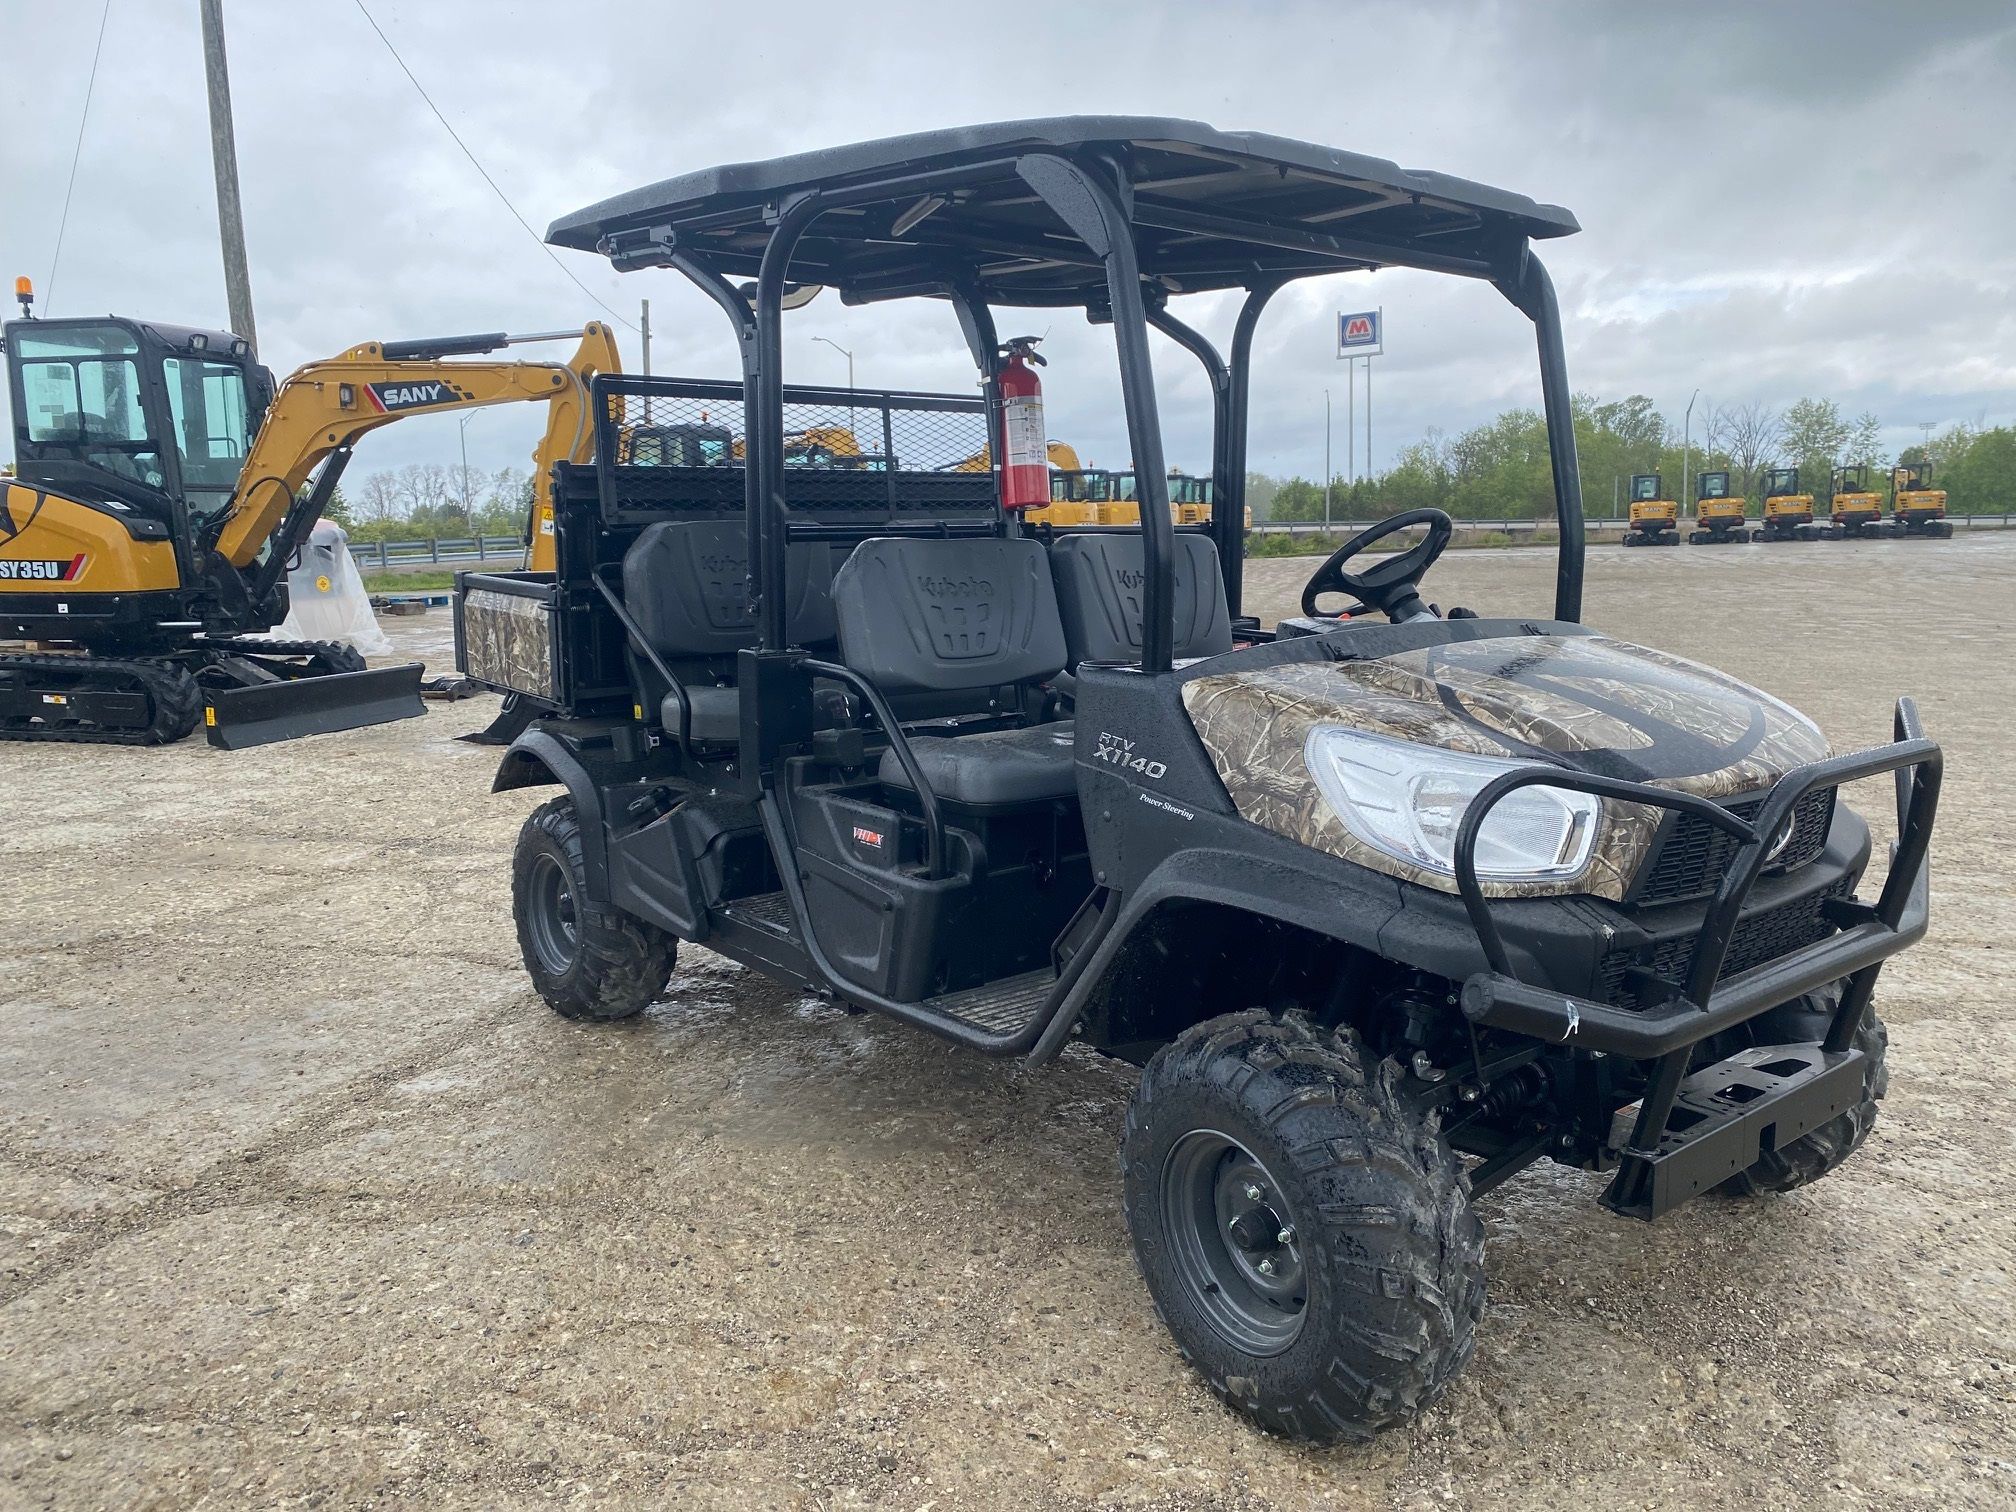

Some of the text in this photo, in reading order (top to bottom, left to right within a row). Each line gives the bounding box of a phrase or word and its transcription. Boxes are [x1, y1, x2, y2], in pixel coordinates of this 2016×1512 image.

[384, 384, 441, 405] SANY
[0, 561, 58, 579] SY35U
[917, 576, 994, 598] Kubota
[1098, 731, 1136, 751] RTV
[1093, 742, 1168, 779] X1140
[1139, 793, 1195, 821] Power Steering
